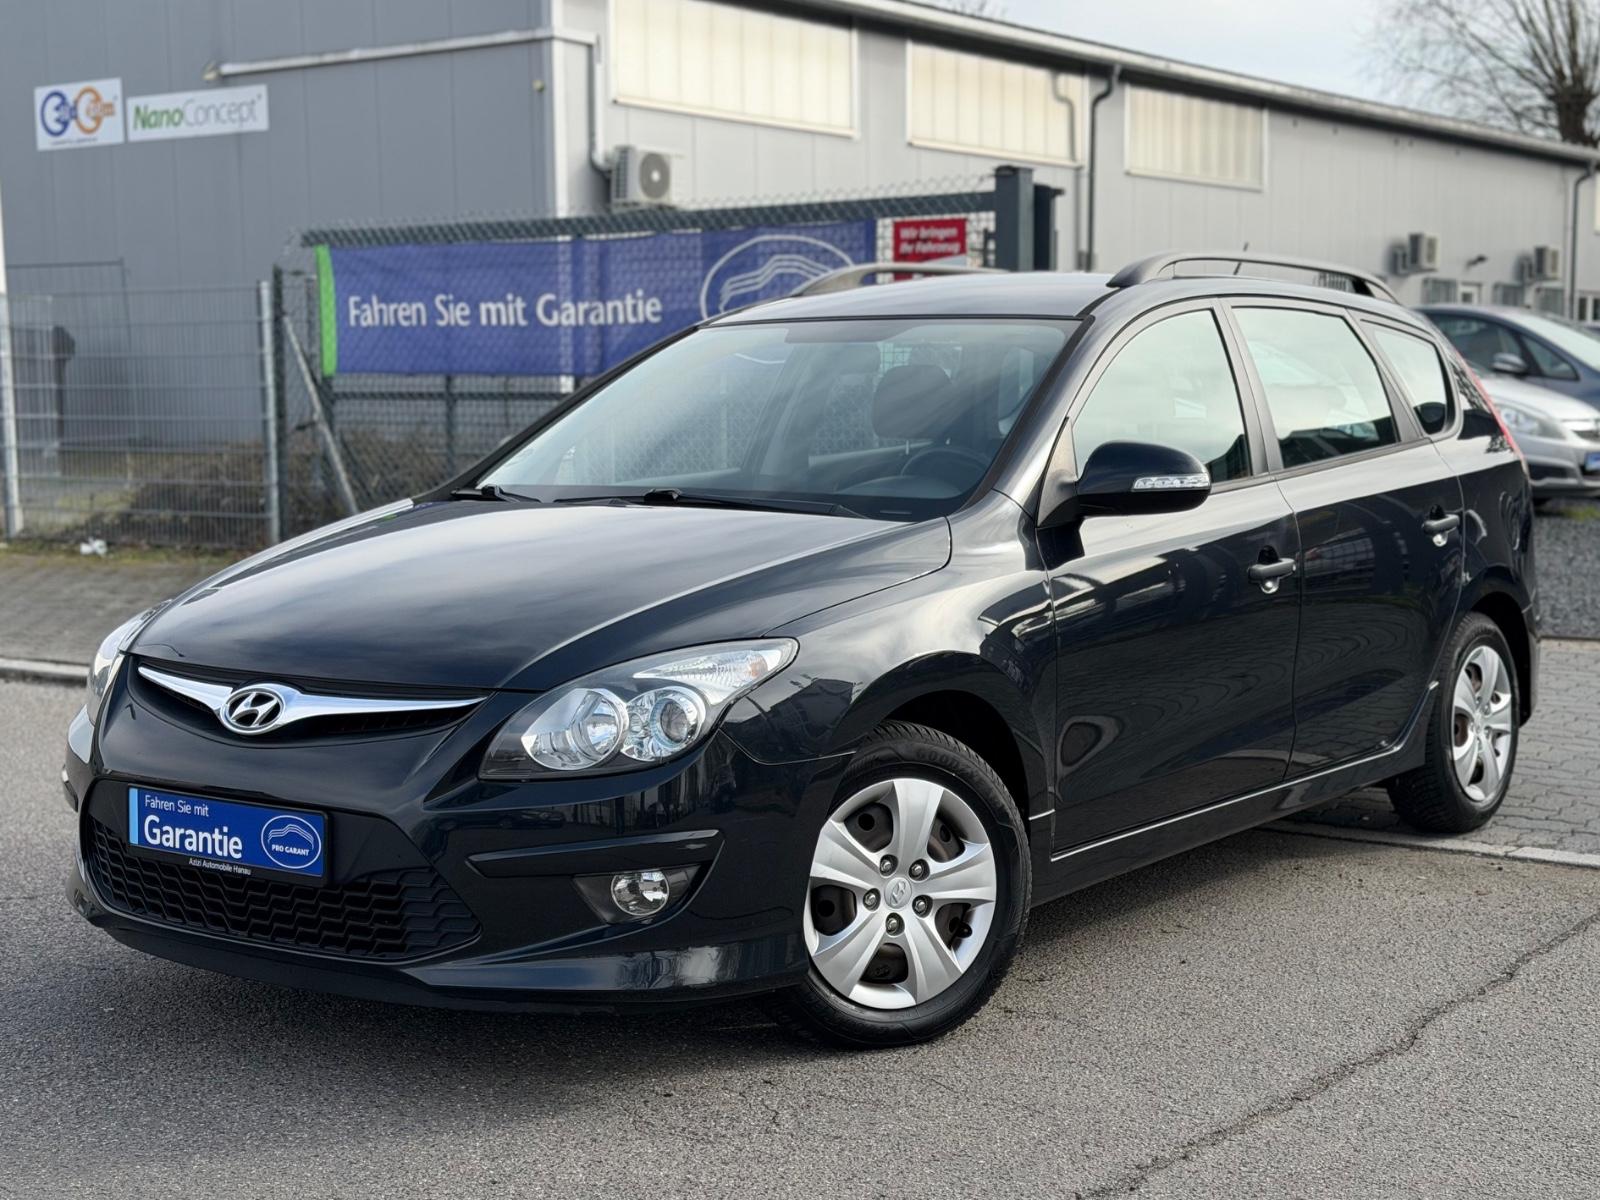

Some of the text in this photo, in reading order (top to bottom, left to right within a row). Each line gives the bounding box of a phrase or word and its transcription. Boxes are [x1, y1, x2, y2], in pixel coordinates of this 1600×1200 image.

[348, 288, 663, 327] Fahren Sie mit Garantie
[144, 794, 209, 818] Fahren Sie mit
[143, 814, 243, 860] Garantie
[271, 844, 310, 857] PRO GARANT
[202, 860, 233, 873] Automobile
[233, 865, 252, 876] Hanau
